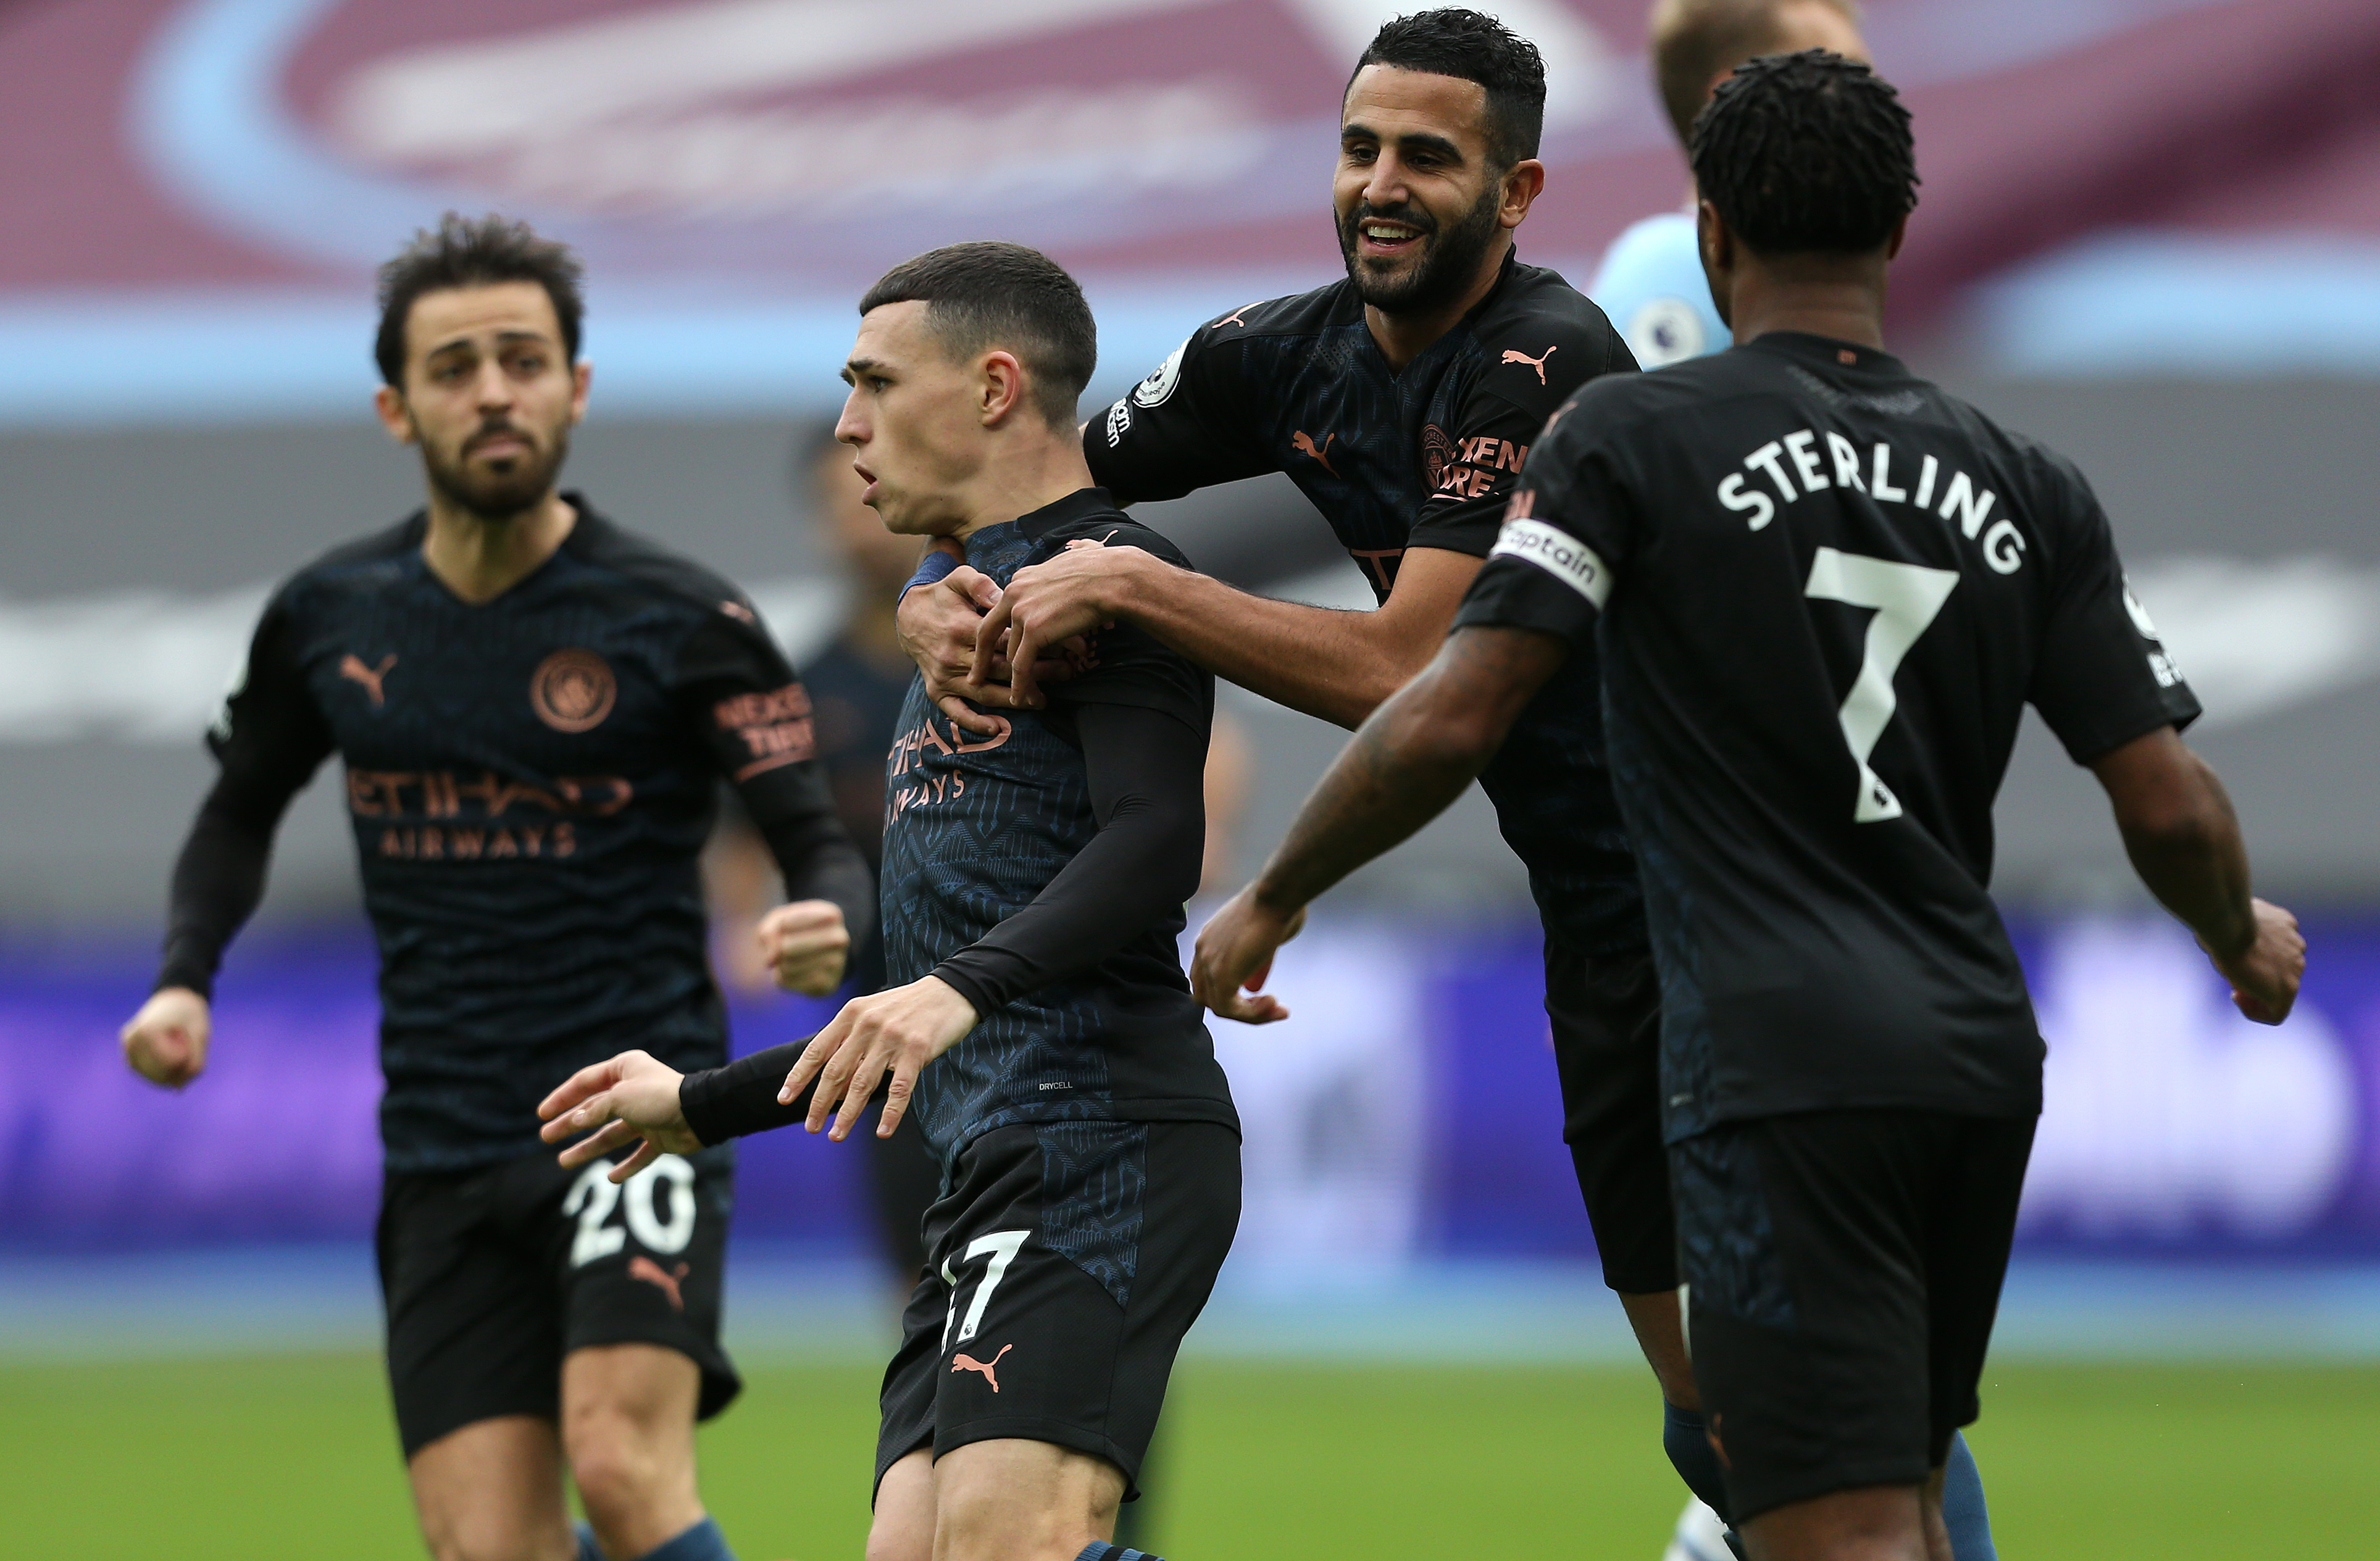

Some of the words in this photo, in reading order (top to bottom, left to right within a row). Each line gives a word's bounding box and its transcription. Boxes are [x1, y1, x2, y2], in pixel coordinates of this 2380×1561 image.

[1451, 436, 1529, 473] XEN
[1718, 429, 2026, 575] STERLING
[1804, 546, 1960, 823] 7
[348, 770, 633, 818] ETIHAD
[379, 822, 577, 859] AIRWAYS
[1039, 1081, 1073, 1091] DRYCELL
[561, 1152, 696, 1269] 20
